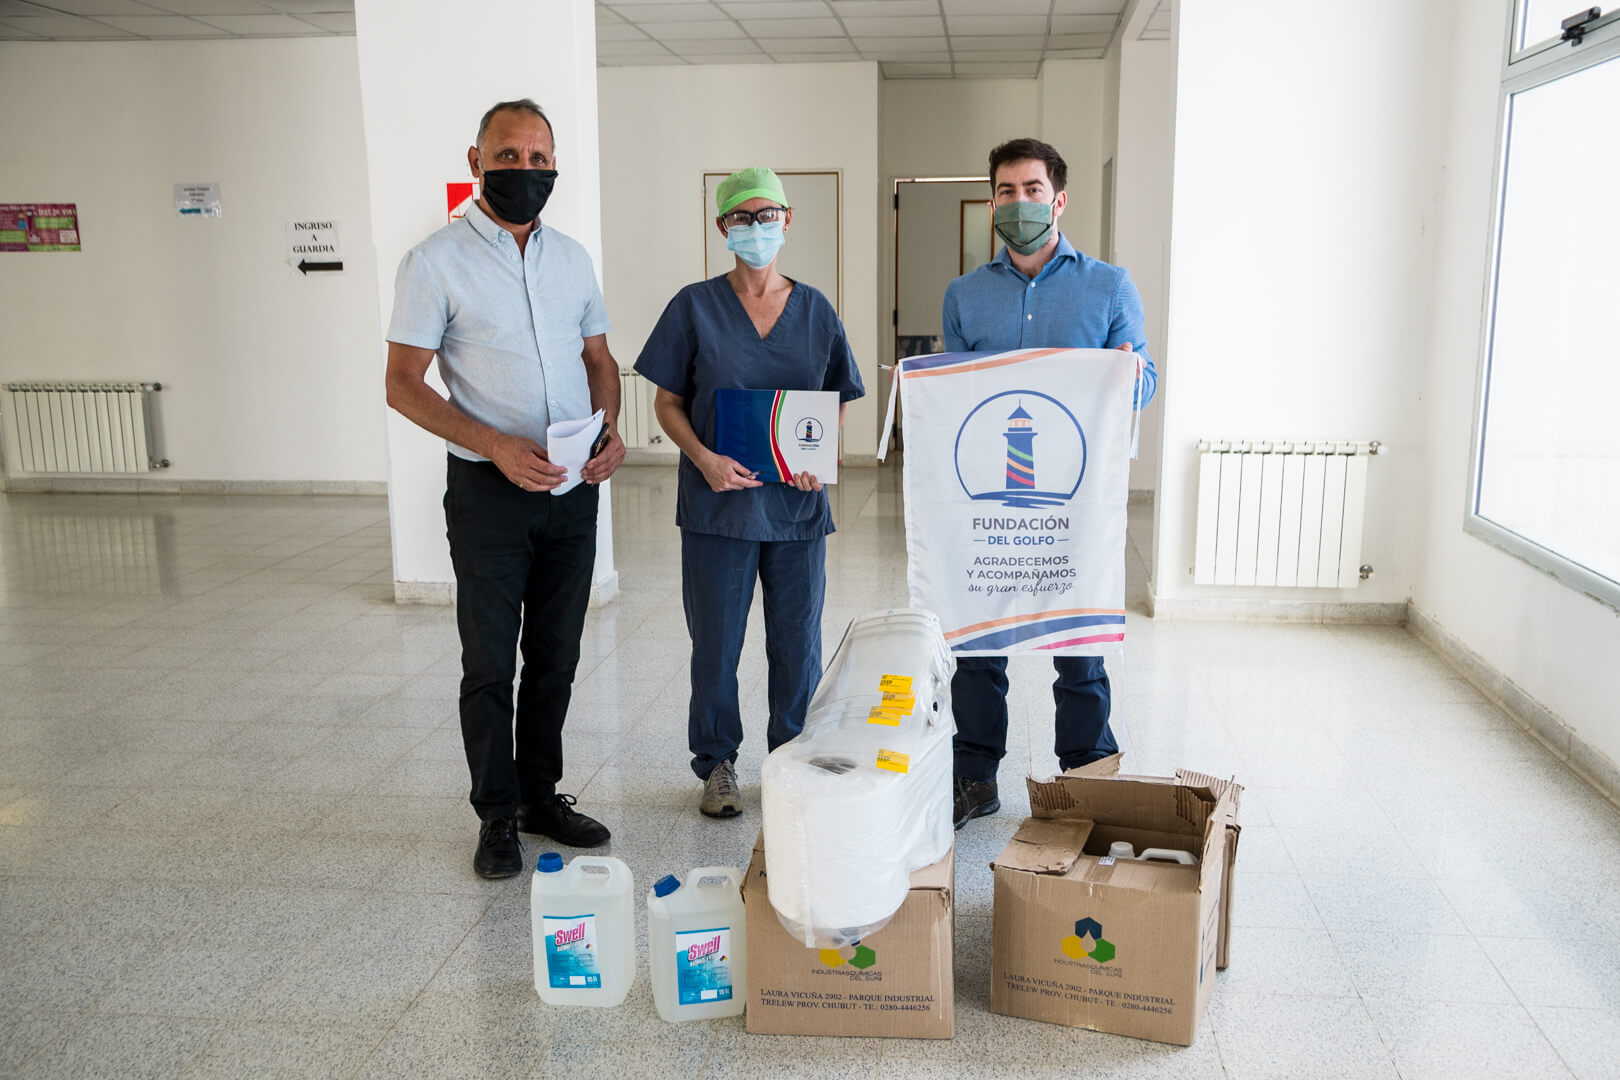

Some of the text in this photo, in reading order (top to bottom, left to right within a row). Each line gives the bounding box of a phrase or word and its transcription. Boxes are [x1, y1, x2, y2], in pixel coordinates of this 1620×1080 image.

[294, 222, 333, 230] INGRESO
[292, 245, 335, 253] GUARDIA
[972, 515, 1070, 530] FUNDACIÓN
[987, 535, 1055, 546] DEL GOLFO
[974, 556, 1070, 566] AGRADECEMOS
[966, 568, 1077, 580] Y ACOMPAÑAMOS
[968, 578, 1074, 597] su gran esfuerzo
[555, 922, 586, 946] Swell
[688, 935, 721, 961] Swell
[760, 988, 789, 998] LAURA
[790, 991, 824, 1000] VICUÑA
[848, 994, 882, 1002] PARQUE
[1003, 971, 1031, 983] LAURA
[1032, 977, 1064, 990] VICUÑA
[1065, 984, 1082, 993] 2902
[1088, 987, 1122, 999] PARQUE
[1123, 993, 1176, 1006] INDUSTRIAL
[761, 998, 795, 1007] TRELEW
[796, 1000, 820, 1009] PROV.
[822, 1001, 857, 1010] CHUBUT
[880, 1003, 931, 1011] 0280-4446256
[1007, 982, 1039, 993] TRELEW
[1040, 988, 1063, 998] PROV.
[1064, 992, 1100, 1004] CHUBUT
[1121, 1001, 1173, 1015] 0280-4446256
